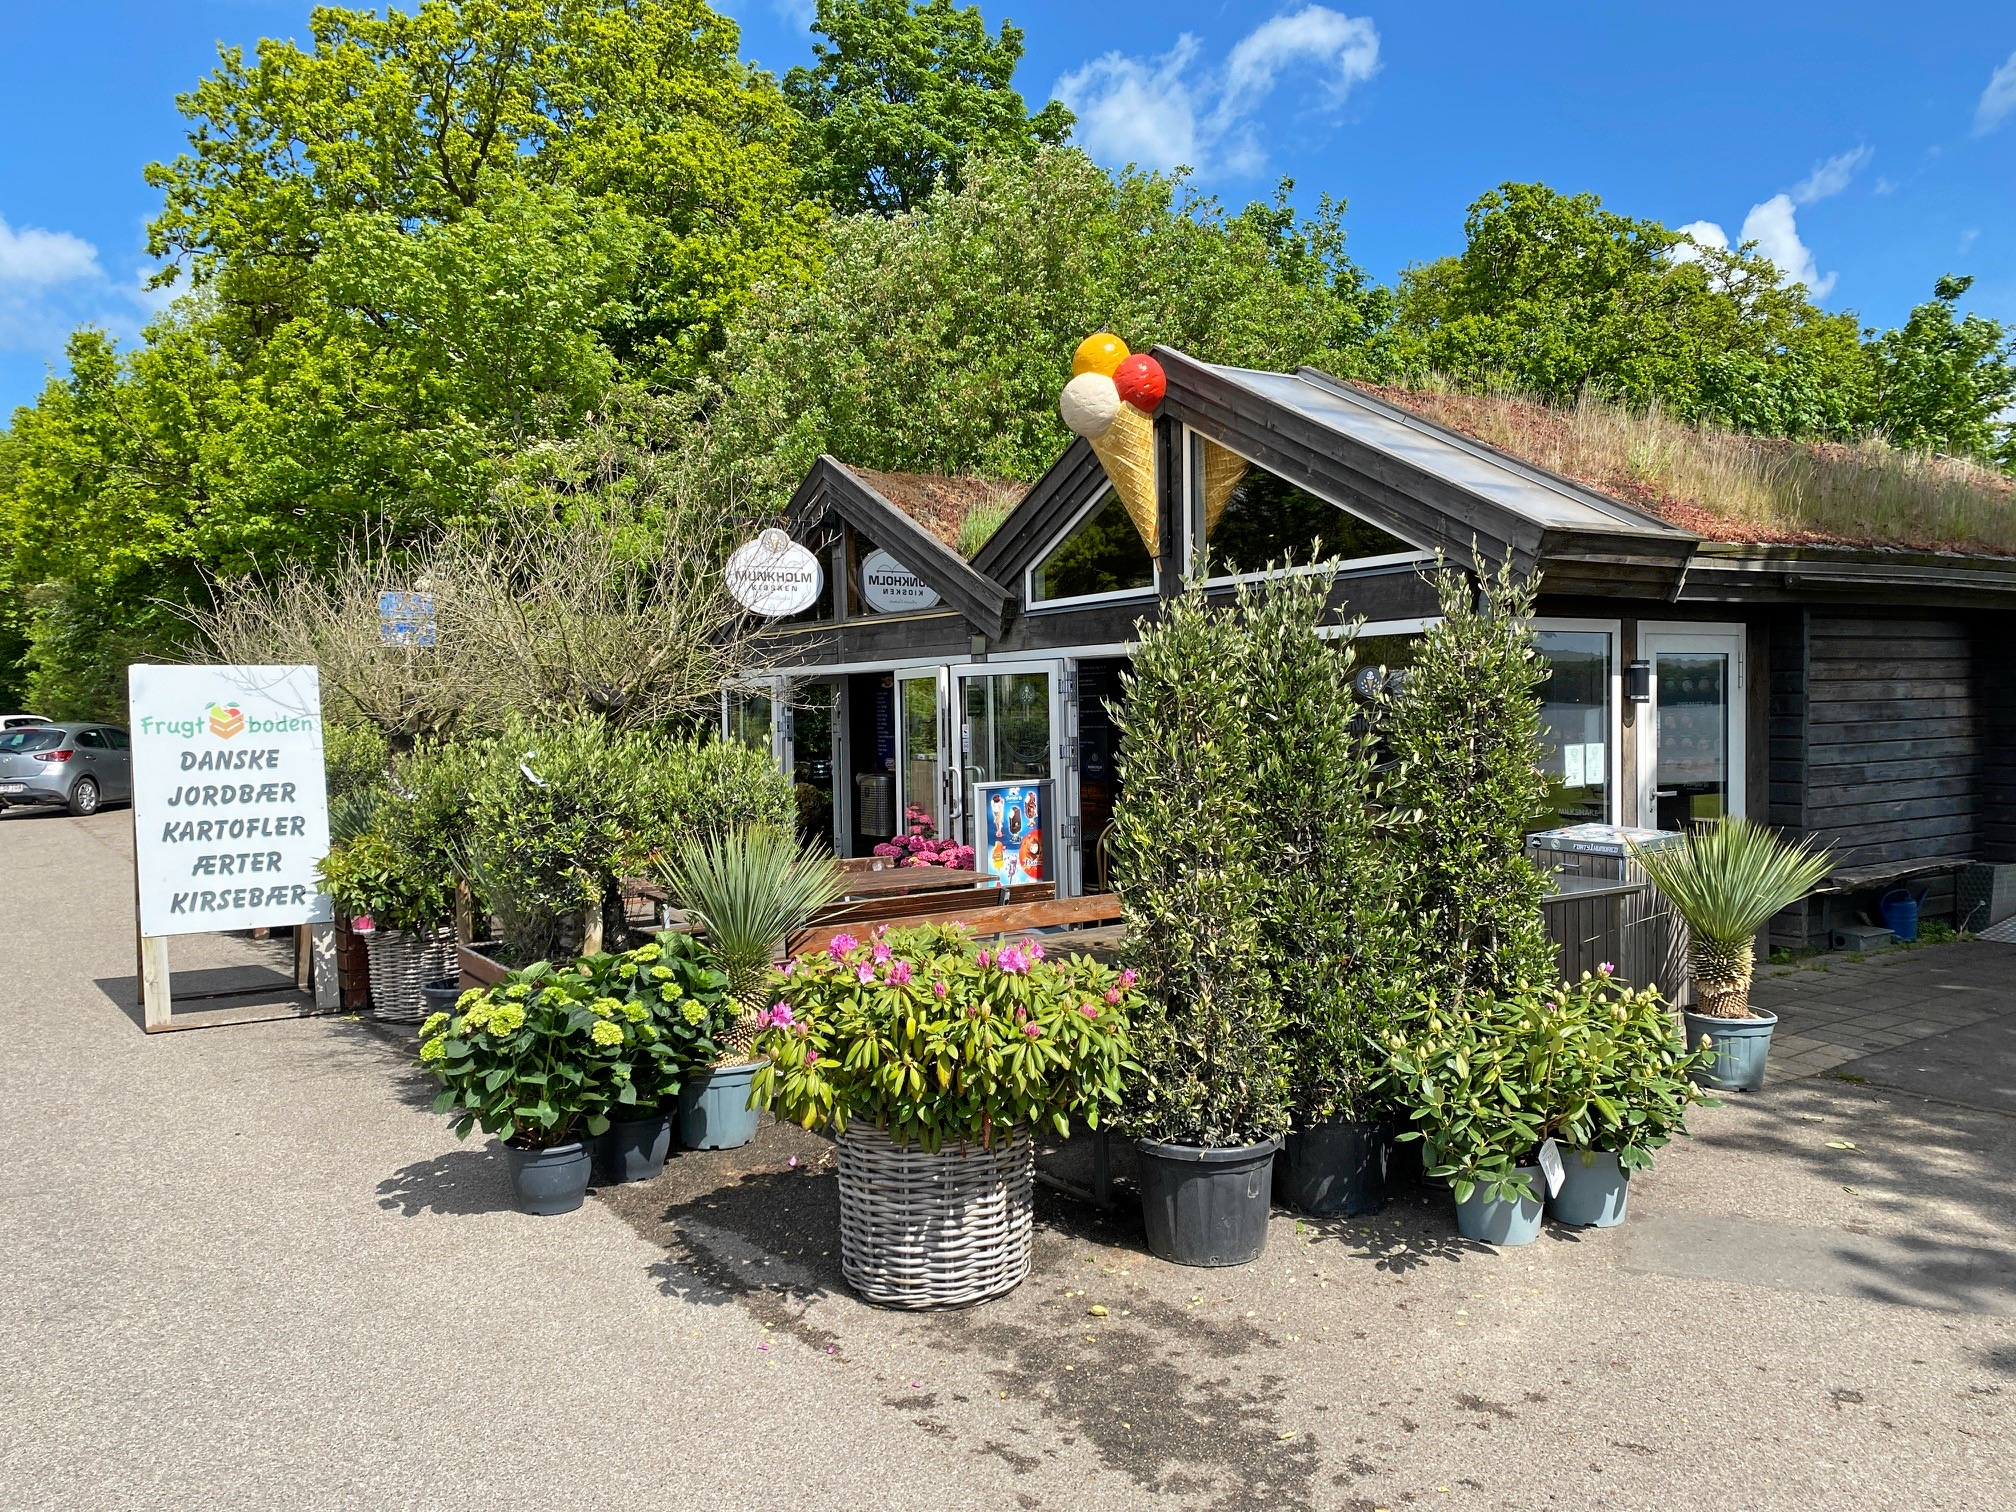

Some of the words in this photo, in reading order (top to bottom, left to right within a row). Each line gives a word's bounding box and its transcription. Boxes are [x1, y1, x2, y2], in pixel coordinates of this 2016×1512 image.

[735, 570, 812, 583] MUNKHOLM
[752, 584, 798, 592] KIOSKEN
[140, 716, 205, 739] Frugt
[248, 715, 313, 734] boden
[180, 749, 280, 771] DANSKE
[167, 782, 297, 807] JORDBÆR
[1558, 807, 1599, 817] MILKSHAKE
[162, 815, 306, 843] KARTOFLER
[191, 851, 283, 877] ÆRTER
[170, 884, 307, 915] KIRSEBÆR
